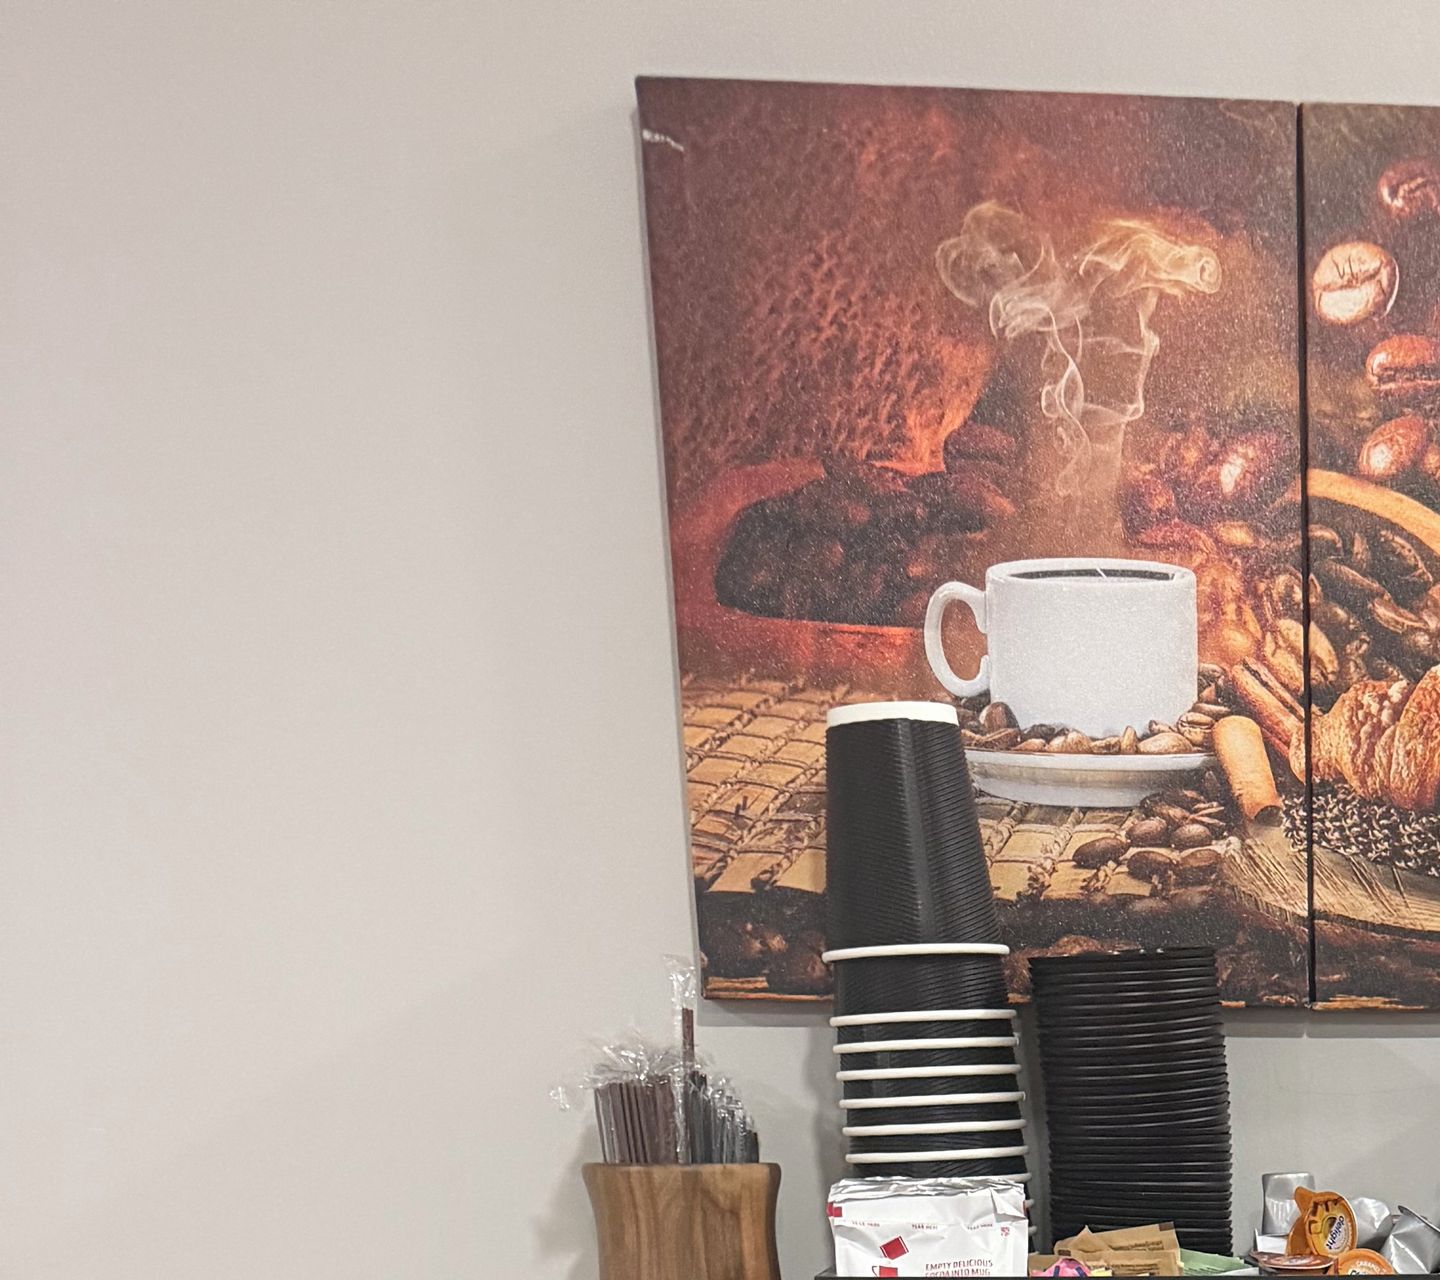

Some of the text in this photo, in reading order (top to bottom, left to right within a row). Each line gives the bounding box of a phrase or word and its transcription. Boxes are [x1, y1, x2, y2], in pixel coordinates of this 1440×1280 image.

[1325, 1215, 1345, 1250] delight
[925, 1258, 993, 1272] EMPTY DELICIOUS
[971, 1267, 991, 1277] MUG
